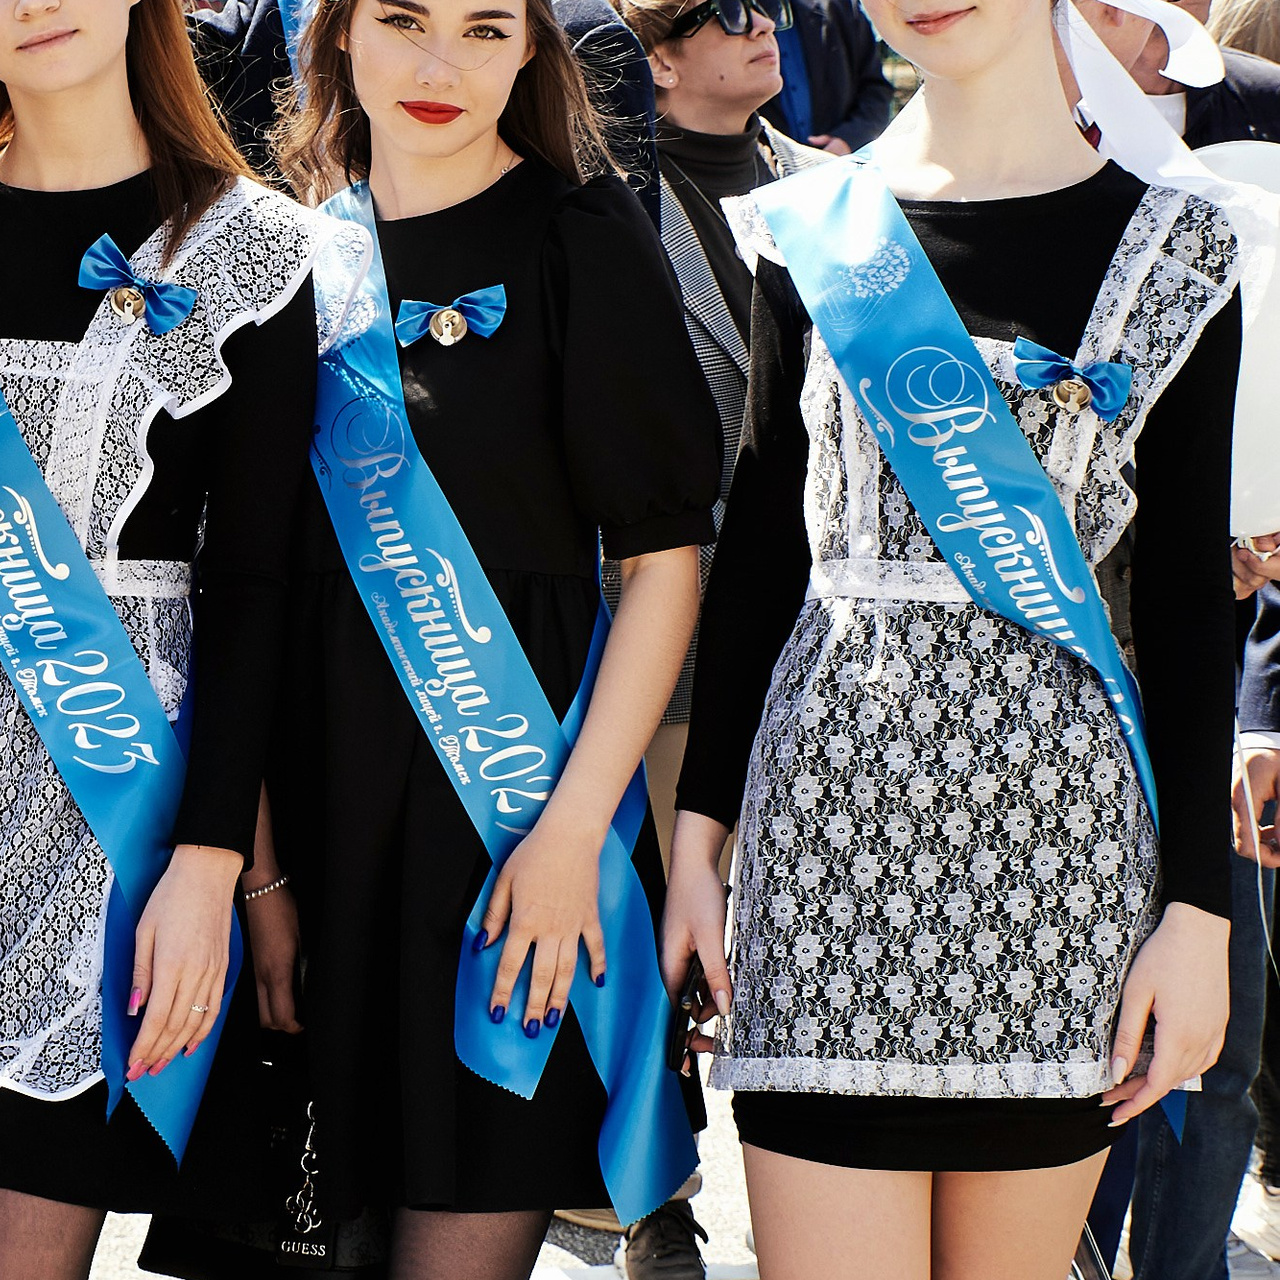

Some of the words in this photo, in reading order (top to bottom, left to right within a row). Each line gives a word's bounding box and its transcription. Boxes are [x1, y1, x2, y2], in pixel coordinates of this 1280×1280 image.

[331, 396, 489, 716] Выпускница
[458, 713, 552, 834] 202
[16, 668, 48, 718] Томск
[36, 650, 160, 774] 2023
[371, 591, 422, 687] Академический
[415, 688, 442, 724] лицей
[438, 734, 471, 786] Томск
[281, 1240, 326, 1257] GUESS
